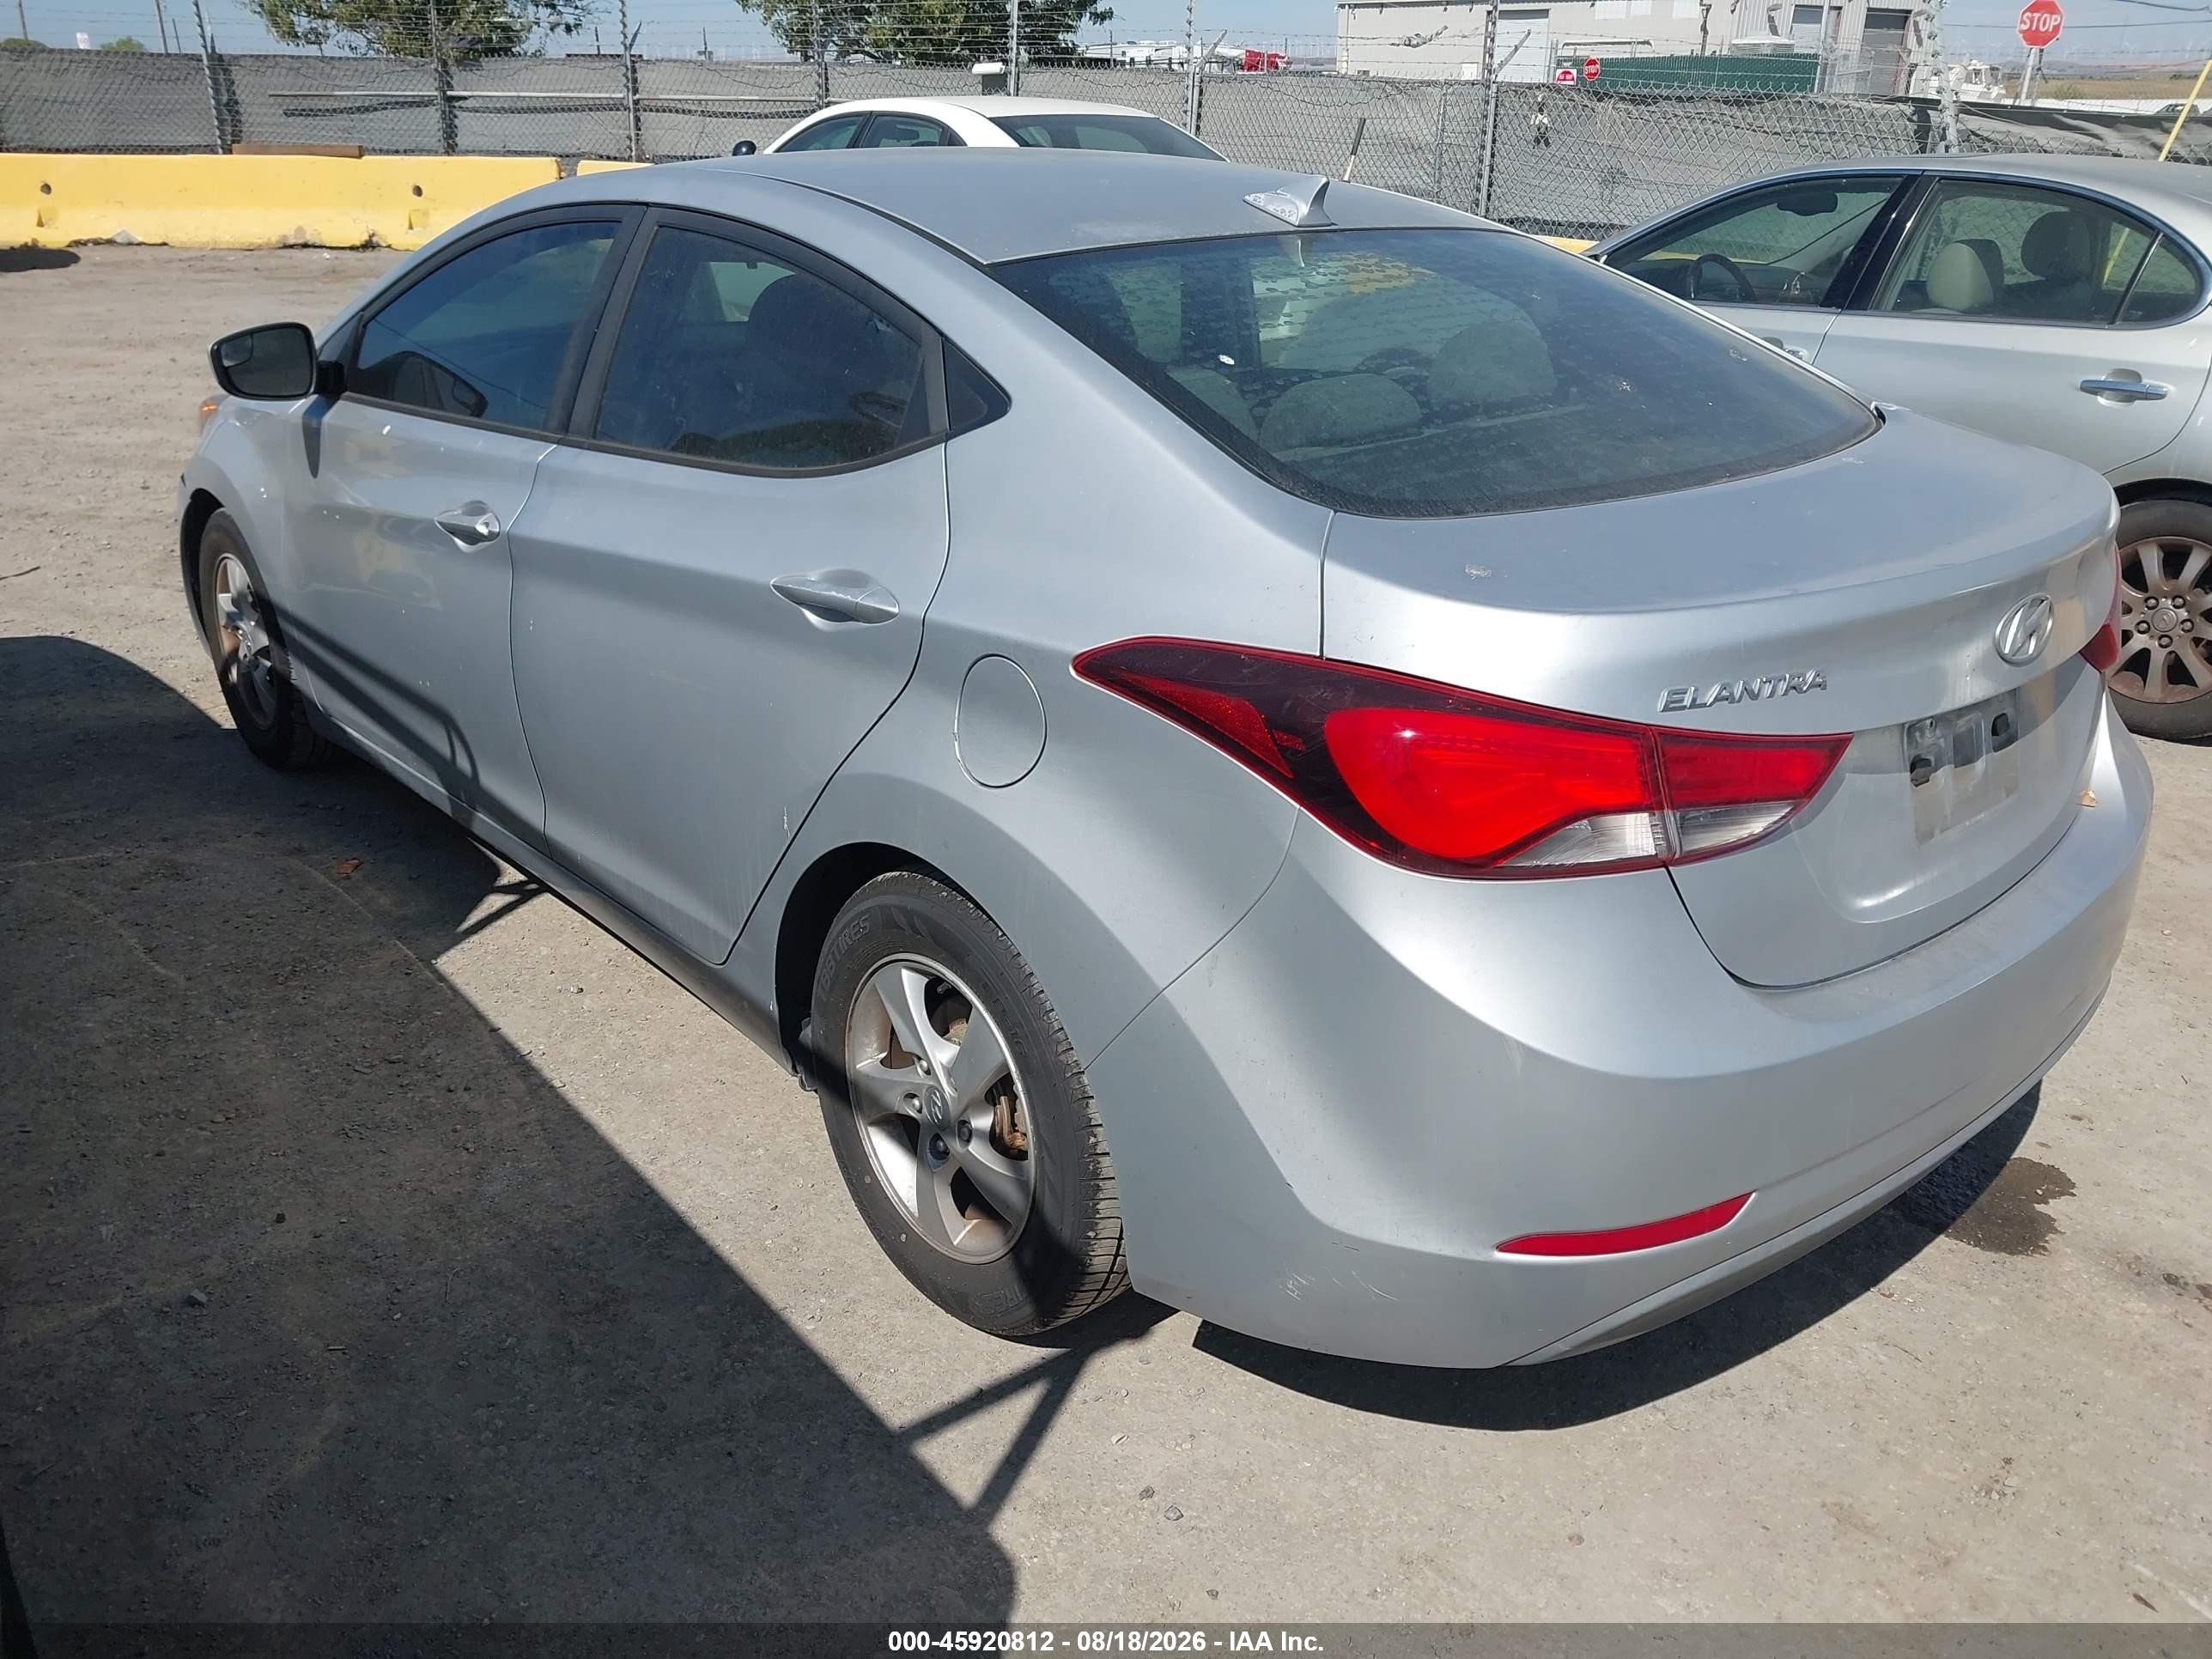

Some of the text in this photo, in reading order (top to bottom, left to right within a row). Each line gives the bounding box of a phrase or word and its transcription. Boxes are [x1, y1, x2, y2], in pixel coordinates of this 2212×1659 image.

[2020, 11, 2061, 33] STOP
[1584, 64, 1599, 75] STOP
[1657, 667, 1827, 713] ELANTRA
